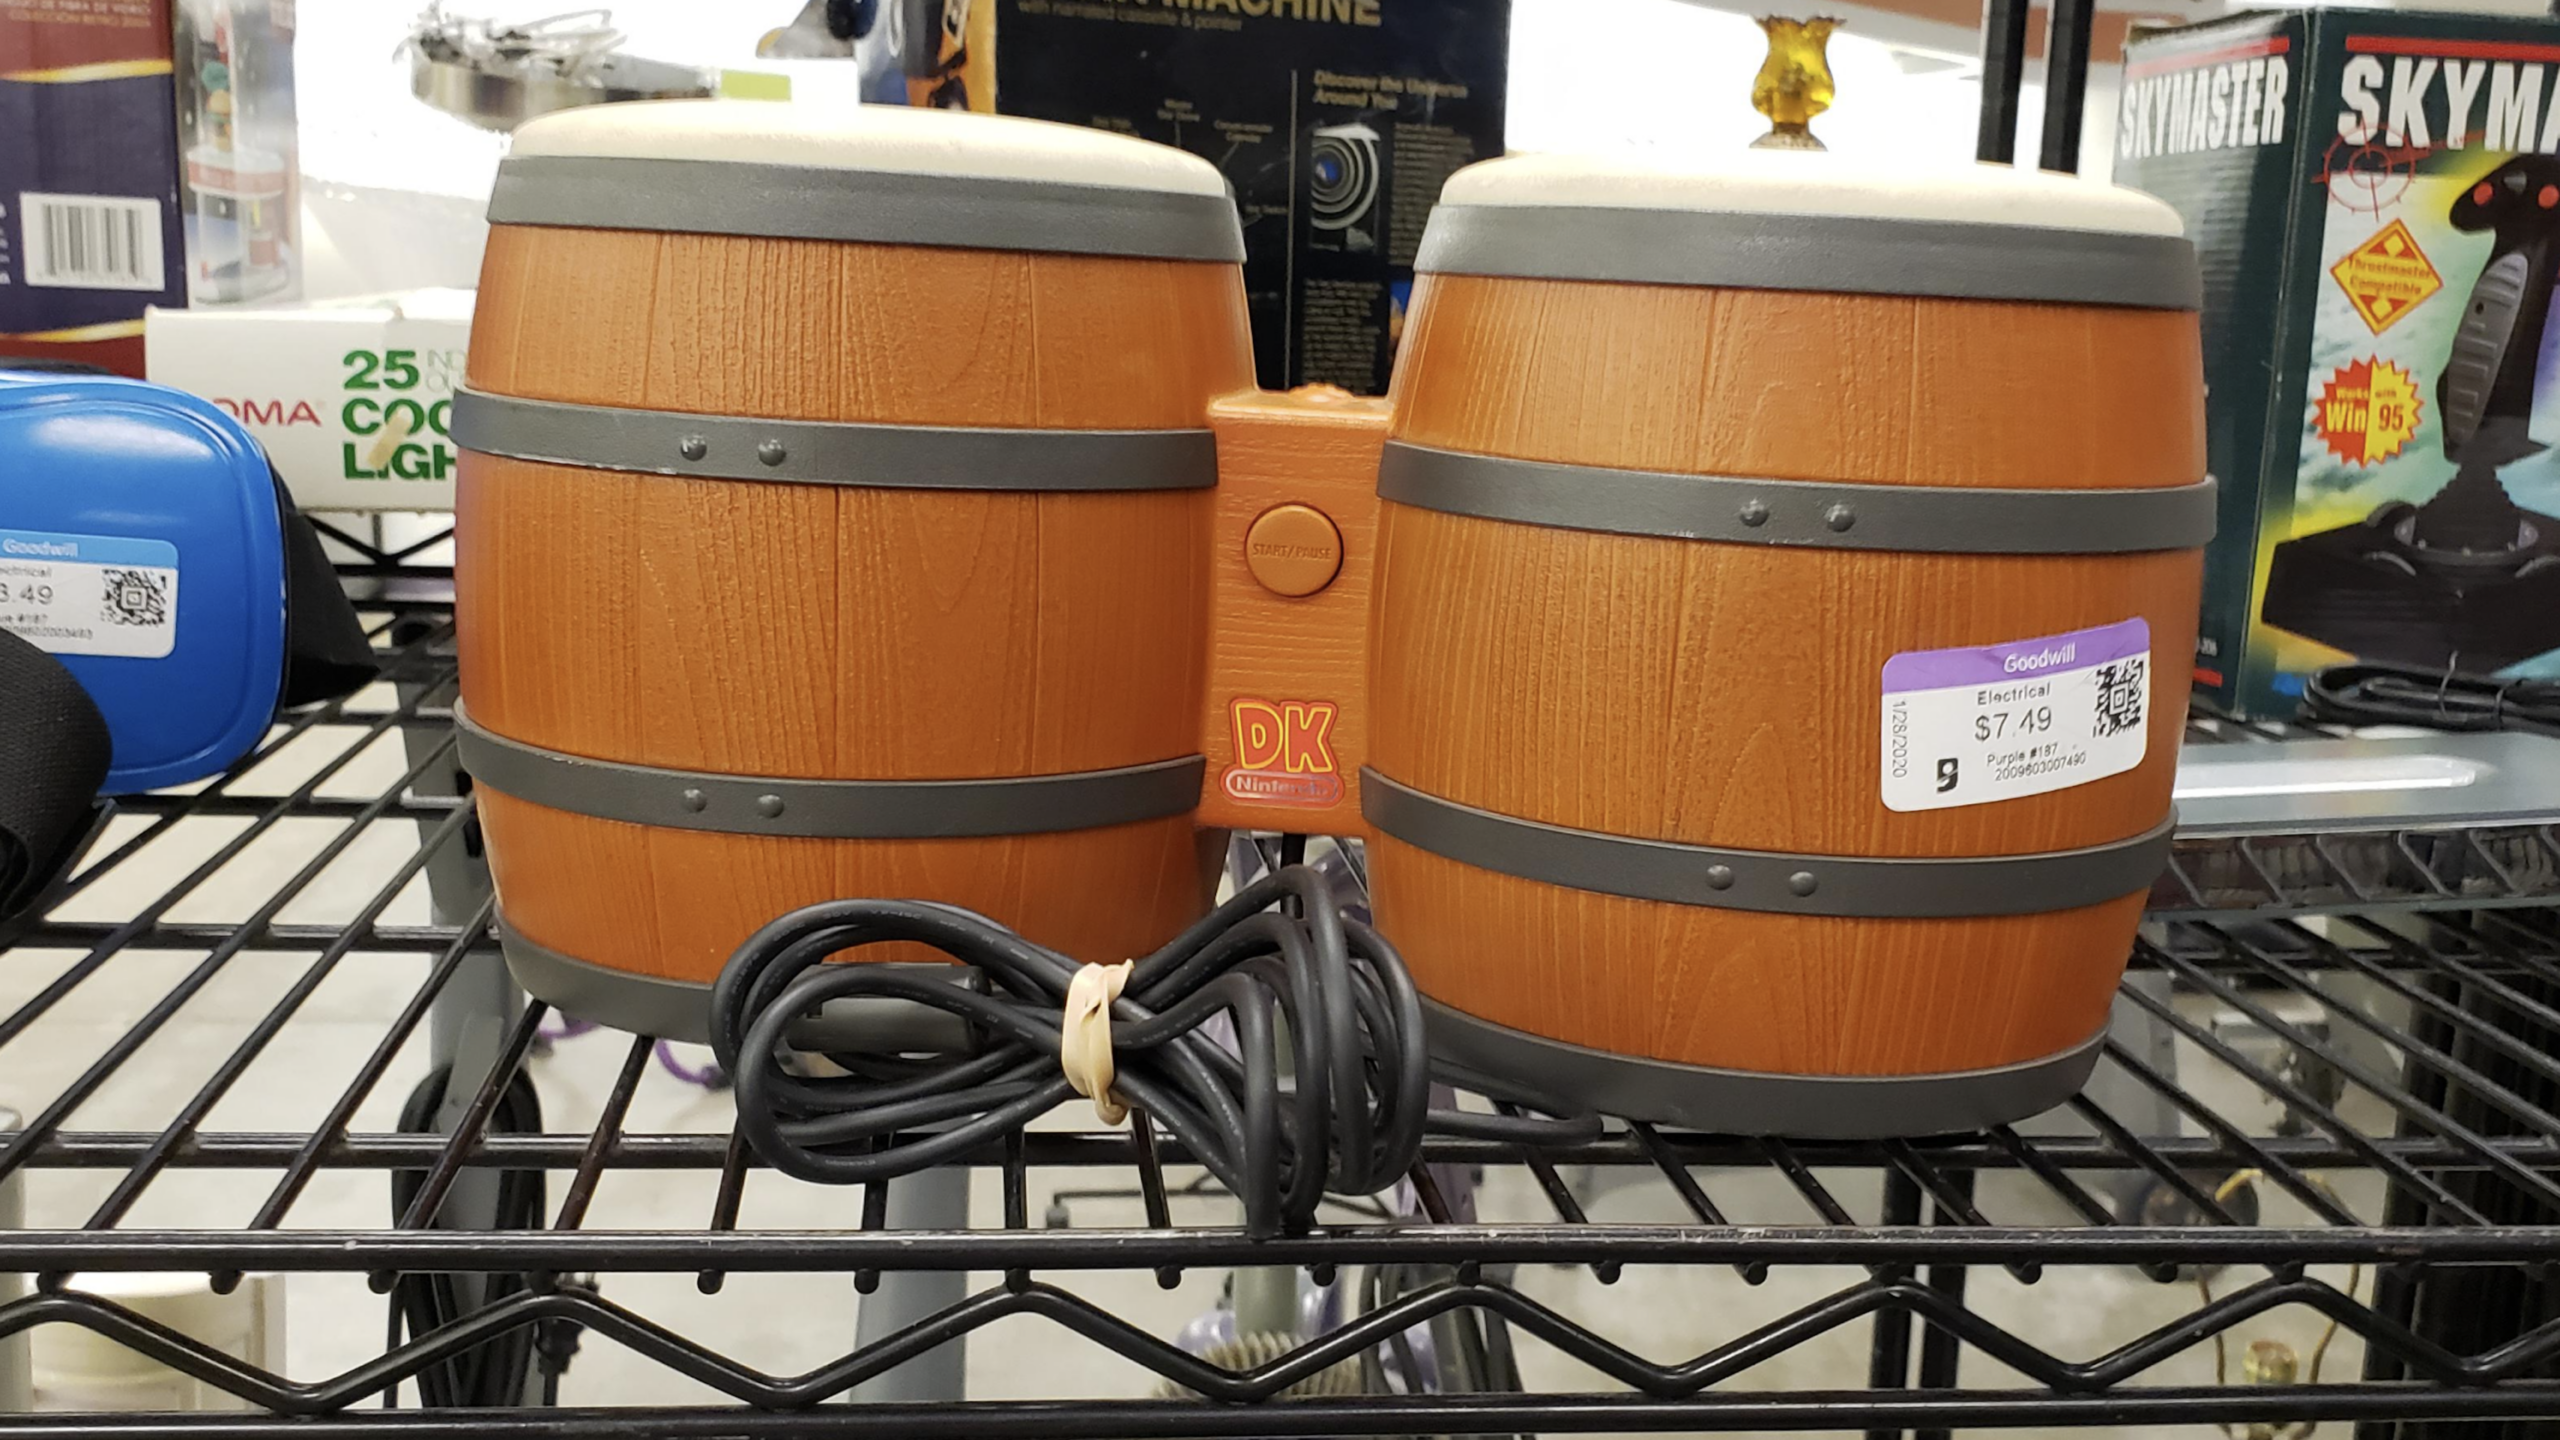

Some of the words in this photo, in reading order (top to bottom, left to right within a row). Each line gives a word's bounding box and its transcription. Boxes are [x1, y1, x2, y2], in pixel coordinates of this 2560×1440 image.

[1162, 0, 1383, 27] HINE
[2121, 54, 2289, 160] SKYMASTER
[2349, 275, 2422, 297] Compatible
[342, 349, 420, 390] 25
[2325, 401, 2367, 433] Win
[2378, 403, 2404, 432] 95
[3, 538, 78, 557] Goodwill
[1253, 543, 1332, 560] START/PAUSE
[2003, 643, 2076, 673] Goodwill
[1977, 682, 2051, 705] Electrical
[1235, 702, 1333, 773] DK
[1892, 701, 1908, 778] 1/28/2020
[1974, 706, 2052, 743] $7.49
[1986, 750, 2026, 767] Purple
[2030, 743, 2058, 759] #187
